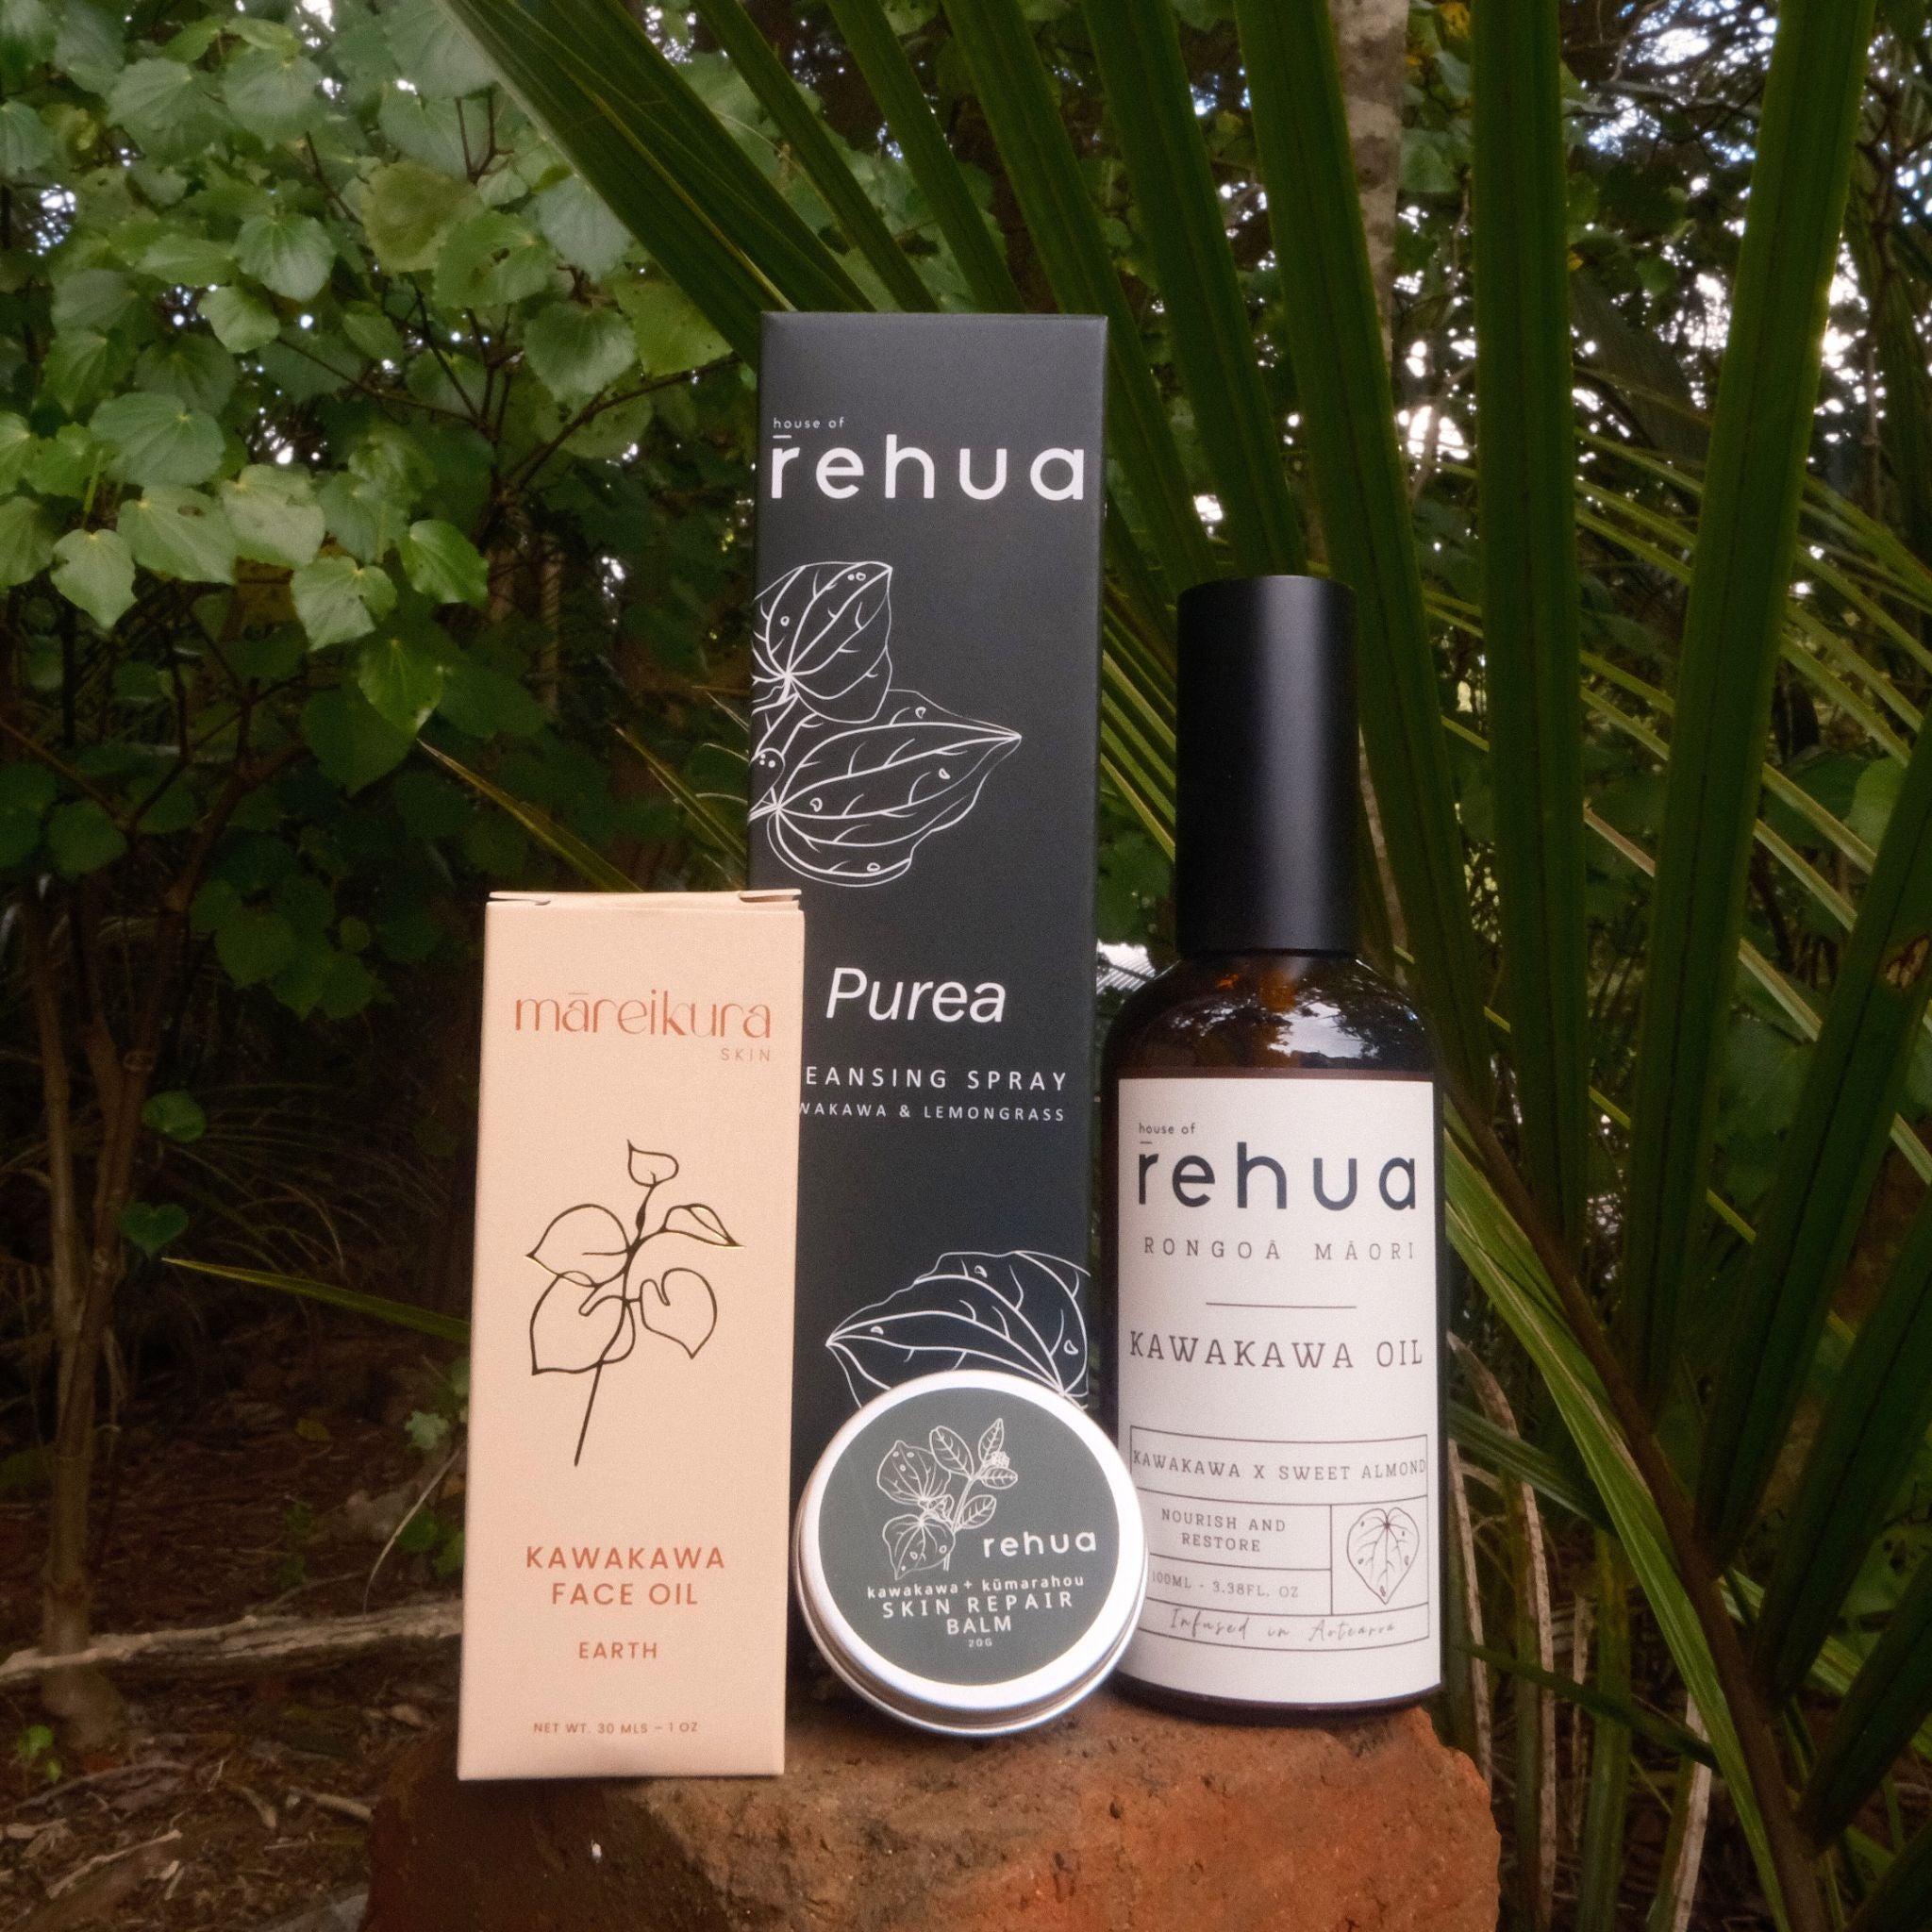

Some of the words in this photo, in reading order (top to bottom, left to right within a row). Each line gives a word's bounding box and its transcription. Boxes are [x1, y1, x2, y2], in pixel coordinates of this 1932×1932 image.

[773, 416, 821, 429] house
[828, 416, 845, 429] of
[825, 966, 1007, 1024] Purea
[514, 989, 772, 1039] māreikura
[721, 1047, 771, 1062] SKIN
[805, 1066, 946, 1089] EANSING
[967, 1070, 1067, 1091] SPRAY
[799, 1102, 887, 1117] WAKAWA
[899, 1104, 911, 1118] &
[924, 1105, 1065, 1122] LEMONGRASS
[1138, 1122, 1174, 1135] house
[1181, 1122, 1196, 1135] of
[1314, 1240, 1414, 1260] MĀORI
[1129, 1330, 1354, 1369] KAWAKAWA
[1375, 1339, 1424, 1368] OIL
[1132, 1449, 1241, 1478] KAWAKAWA
[1253, 1464, 1265, 1479] X
[1278, 1465, 1351, 1481] SWEET
[1360, 1457, 1426, 1479] ALMOND
[1160, 1507, 1238, 1531] NOURISH
[1248, 1518, 1286, 1533] AND
[982, 1530, 1097, 1558] rehua
[1181, 1532, 1261, 1553] RESTORE
[525, 1545, 725, 1570] KAWAKAWA
[552, 1582, 634, 1606] FACE
[648, 1582, 699, 1606] OIL
[867, 1582, 958, 1600] kawakawa
[963, 1580, 973, 1590] +
[1151, 1570, 1192, 1590] 100ML
[1278, 1585, 1299, 1599] OZ
[882, 1597, 951, 1619] SKIN
[967, 1591, 1074, 1614] REPAIR
[946, 1615, 1012, 1636] BALM
[1169, 1607, 1250, 1641] Infused
[1267, 1627, 1290, 1638] in
[578, 1641, 658, 1659] EARTH
[968, 1638, 993, 1649] 20G
[533, 1722, 559, 1734] NET
[566, 1722, 592, 1734] WT.
[597, 1723, 615, 1734] 30
[621, 1723, 648, 1734] MLS
[679, 1721, 699, 1733] OZ
